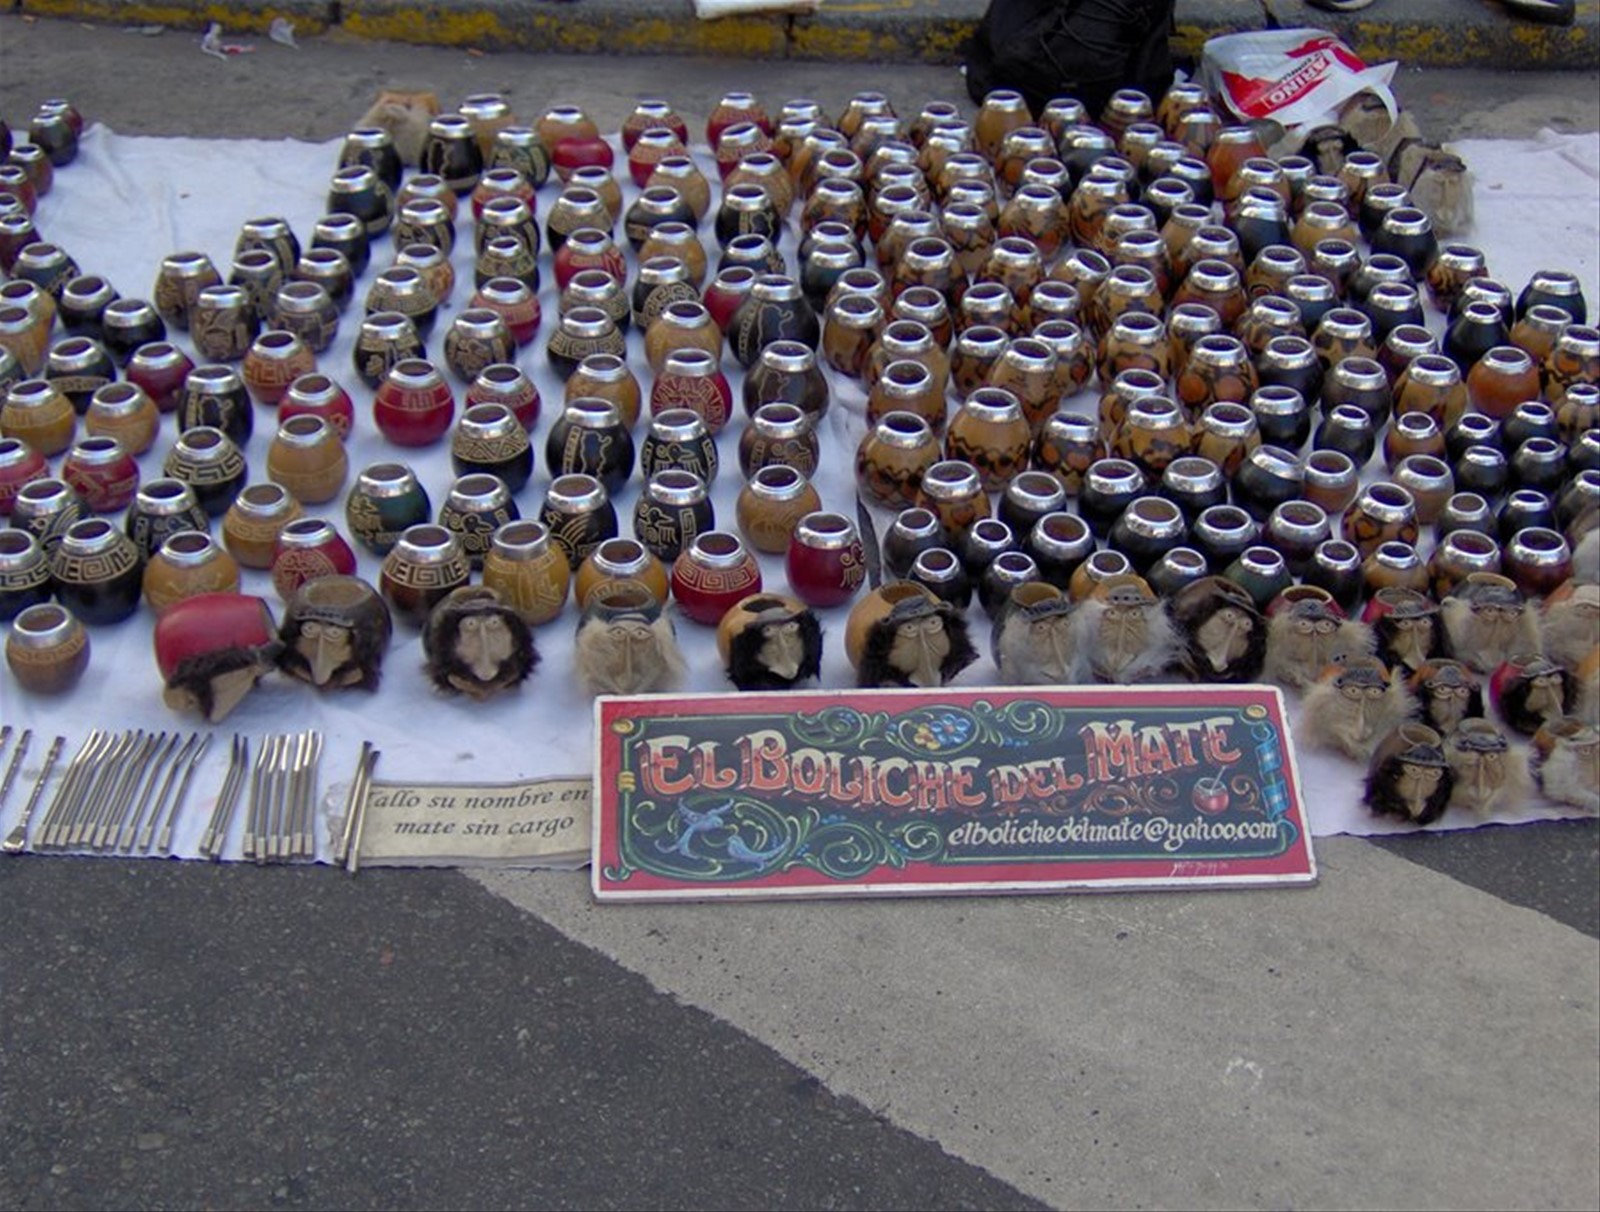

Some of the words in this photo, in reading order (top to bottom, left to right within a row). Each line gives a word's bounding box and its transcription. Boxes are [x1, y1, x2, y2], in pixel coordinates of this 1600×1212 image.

[636, 733, 737, 796] EL
[735, 729, 987, 811] BOLICHE
[989, 756, 1084, 804] DEL
[1079, 716, 1243, 783] MATE
[427, 795, 454, 809] su
[464, 788, 553, 809] nombre
[561, 787, 590, 801] en
[394, 821, 455, 835] mate
[462, 818, 499, 836] sin
[508, 815, 574, 838] cargo
[948, 815, 1278, 852] elbolichedelmate@yahoo.com
